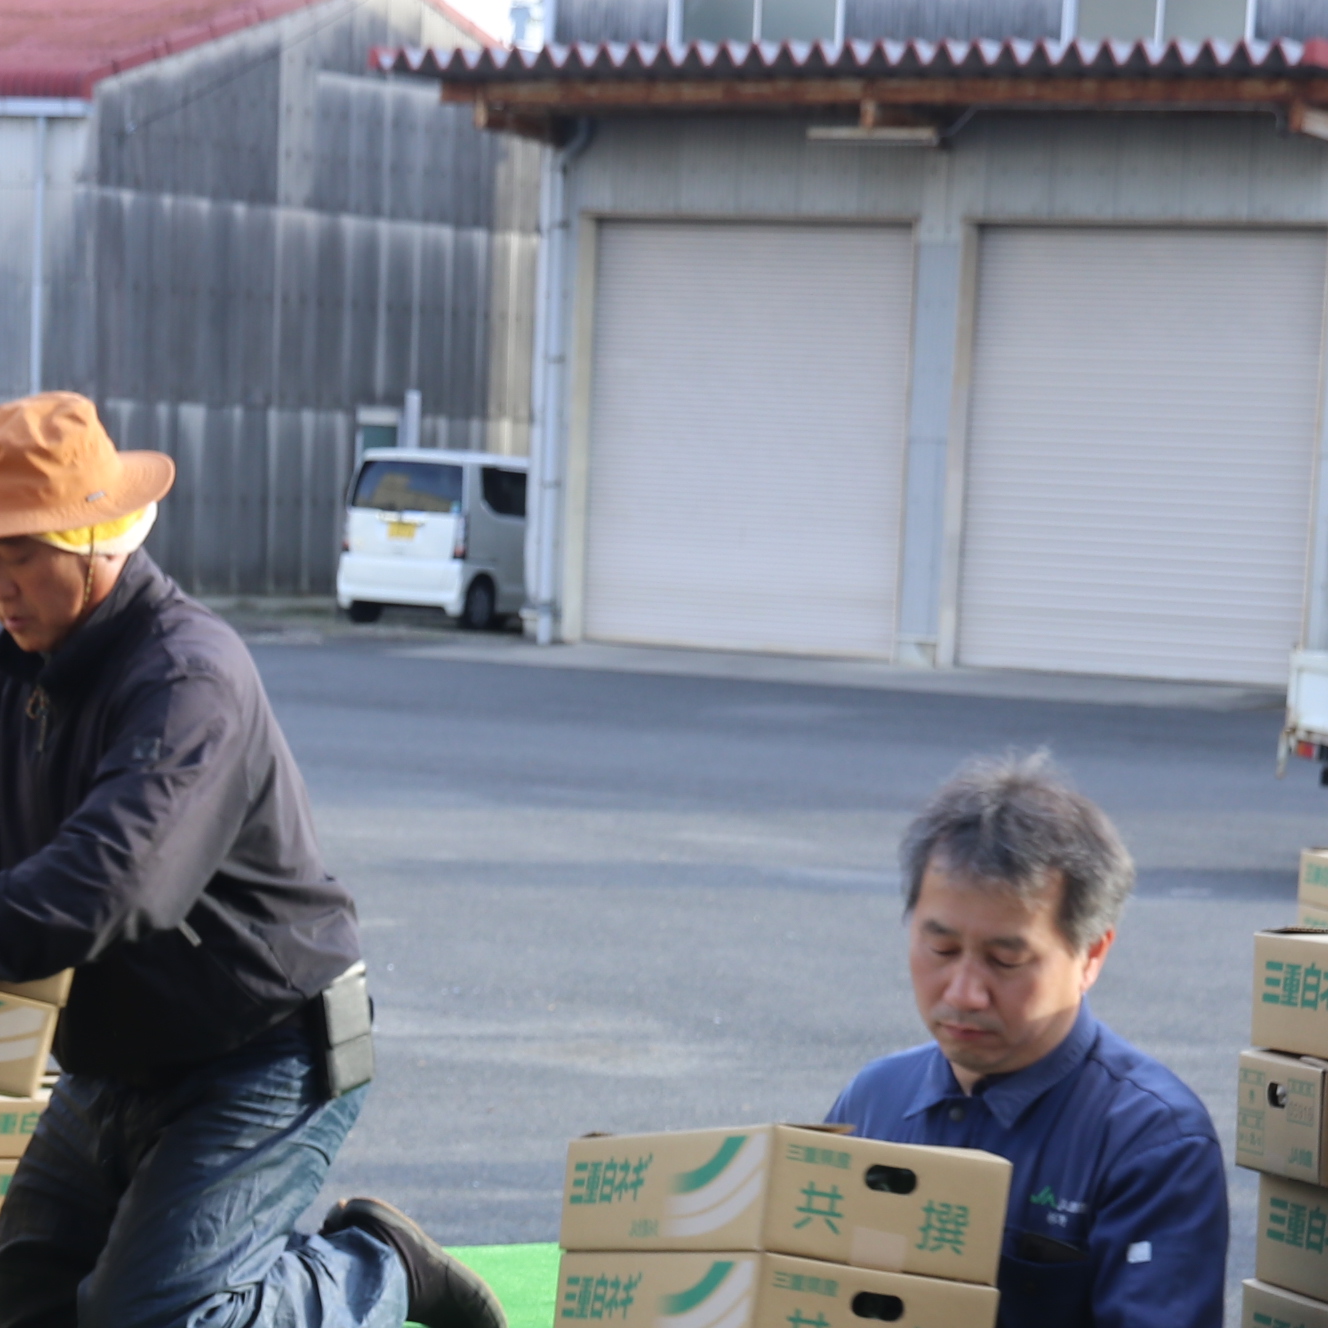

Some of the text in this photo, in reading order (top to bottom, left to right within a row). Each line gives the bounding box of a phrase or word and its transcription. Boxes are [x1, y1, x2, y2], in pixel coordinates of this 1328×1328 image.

[570, 1153, 653, 1206] 三重白ネギ
[795, 1183, 968, 1254] 共 撰
[561, 1272, 643, 1321] 三重白ネギ
